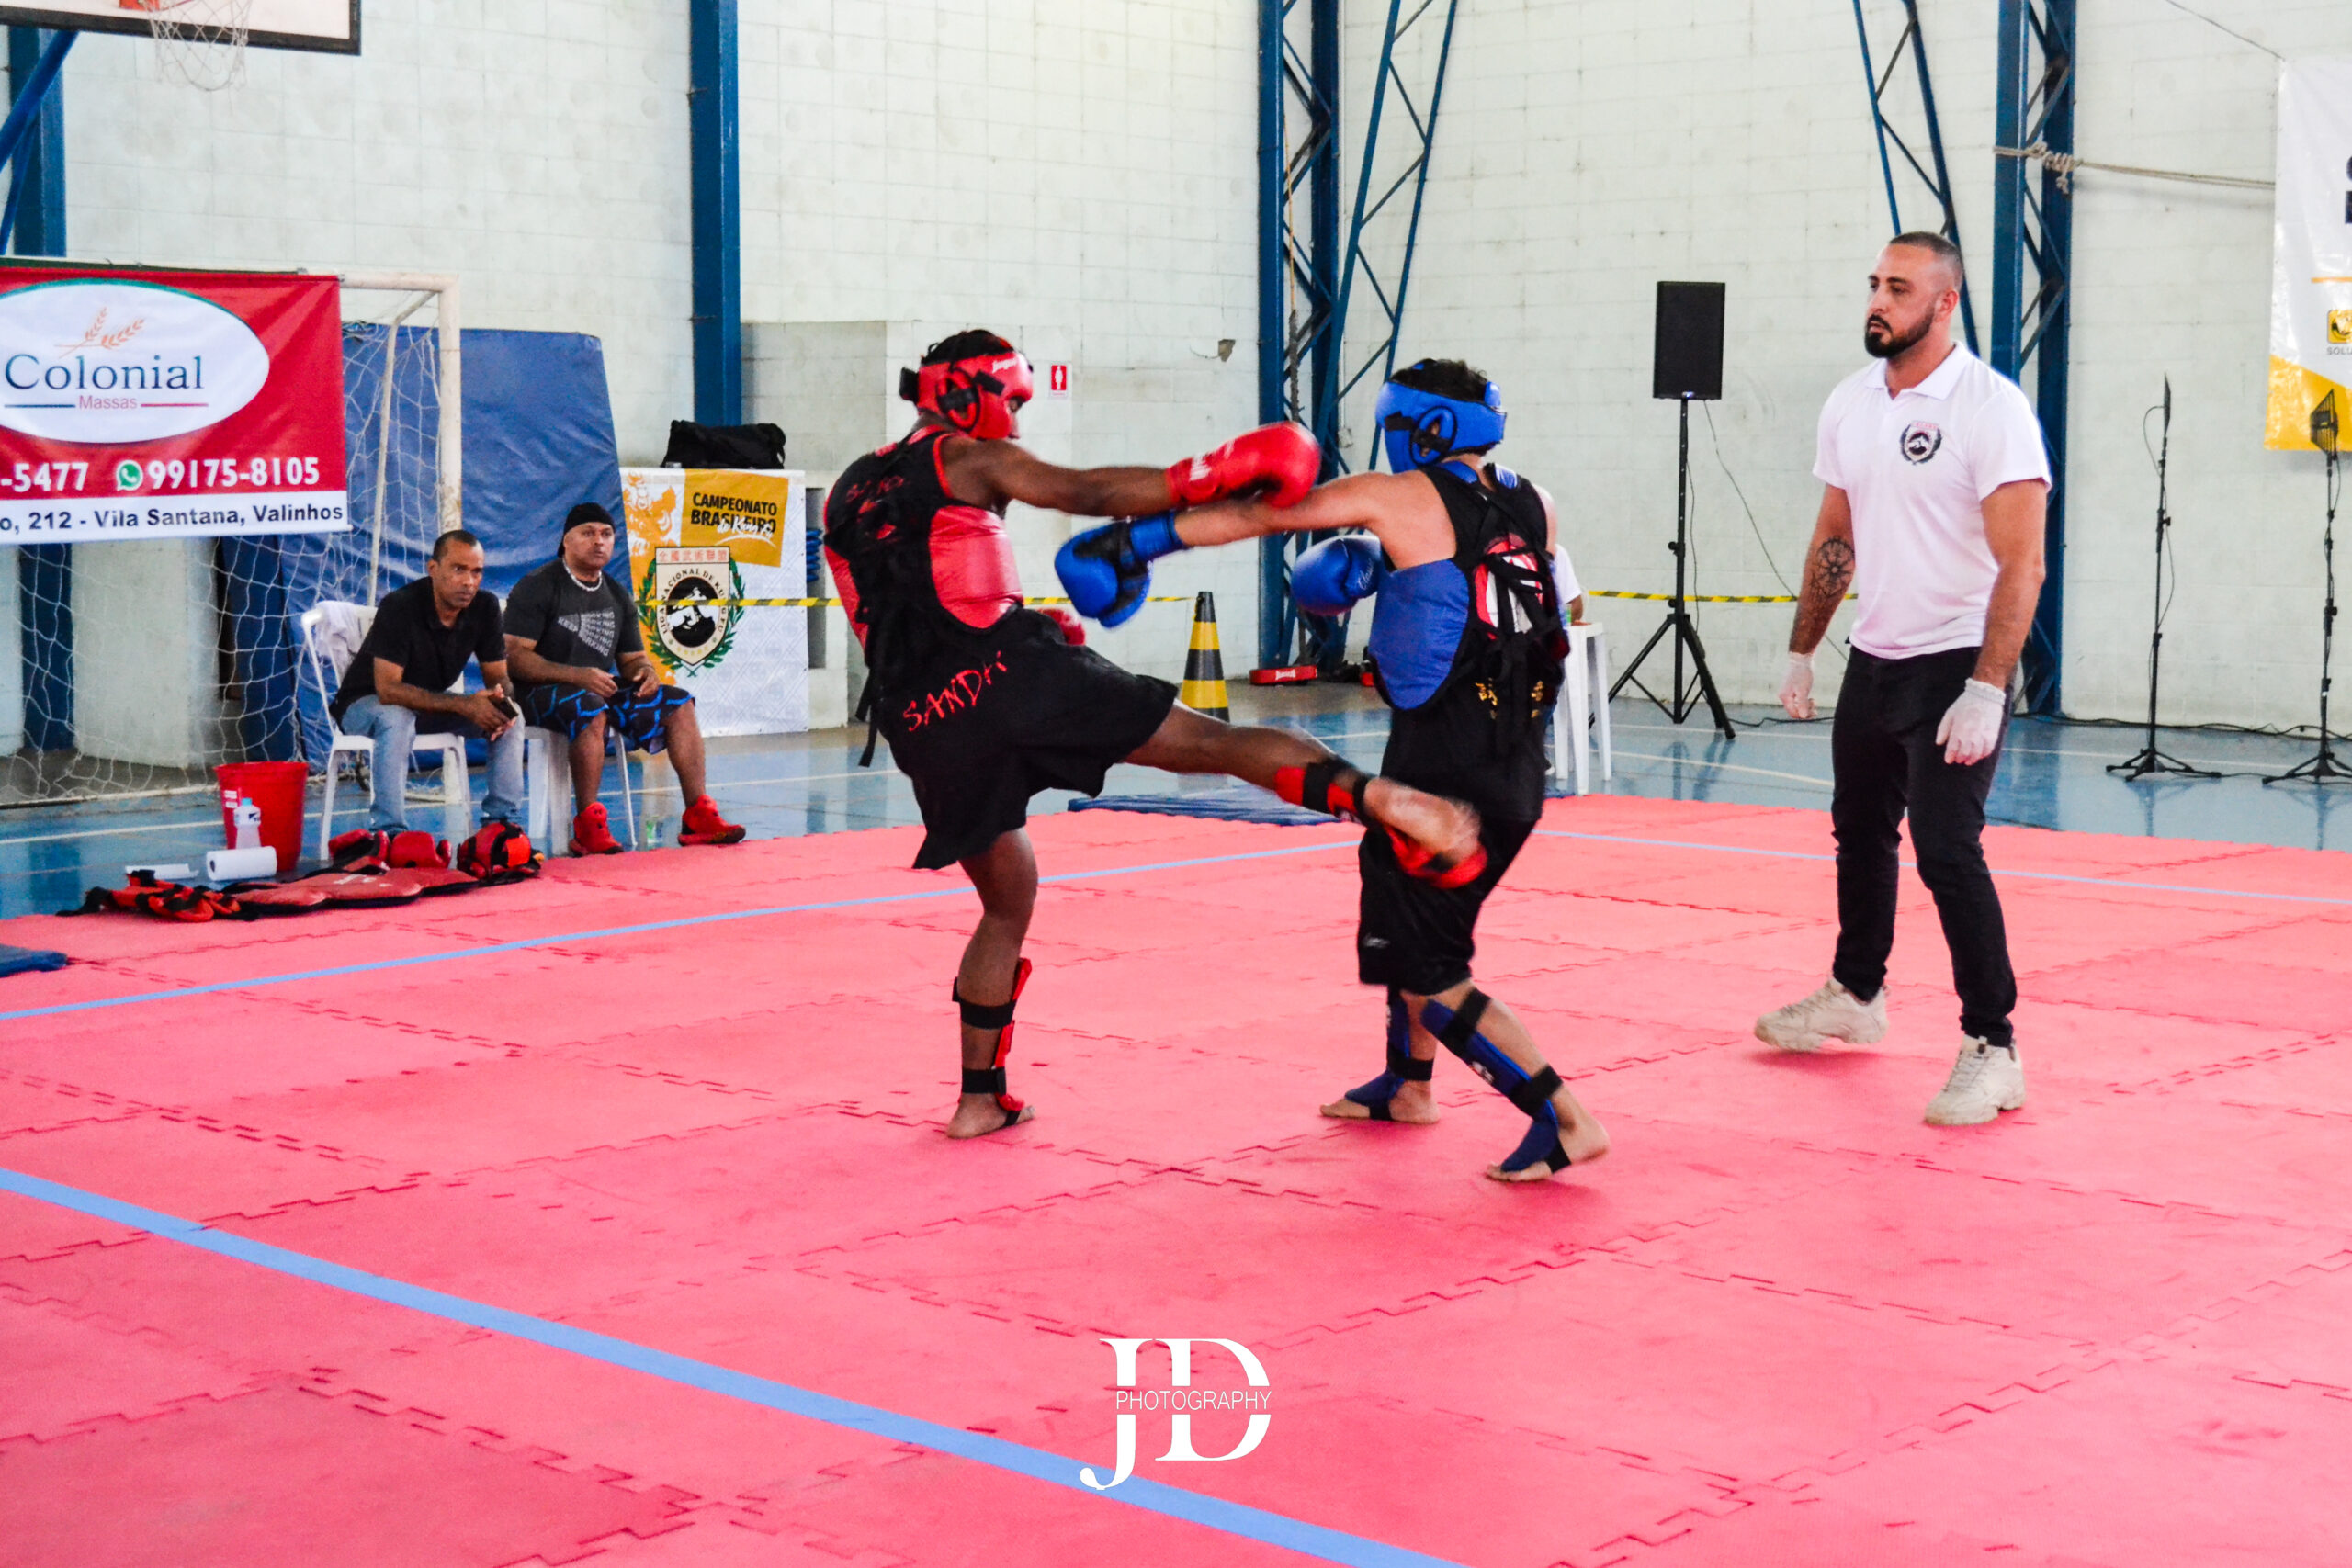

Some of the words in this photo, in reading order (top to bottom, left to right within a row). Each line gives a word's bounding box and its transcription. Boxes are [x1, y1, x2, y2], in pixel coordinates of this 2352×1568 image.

[5, 353, 205, 390] Colonial
[79, 395, 138, 410] Massas
[147, 457, 320, 489] 99175-8105
[29, 511, 72, 530] 212
[94, 510, 138, 528] Vila
[147, 506, 245, 526] Santana,
[254, 503, 343, 522] Valinhos
[693, 491, 777, 516] CAMPEONATO
